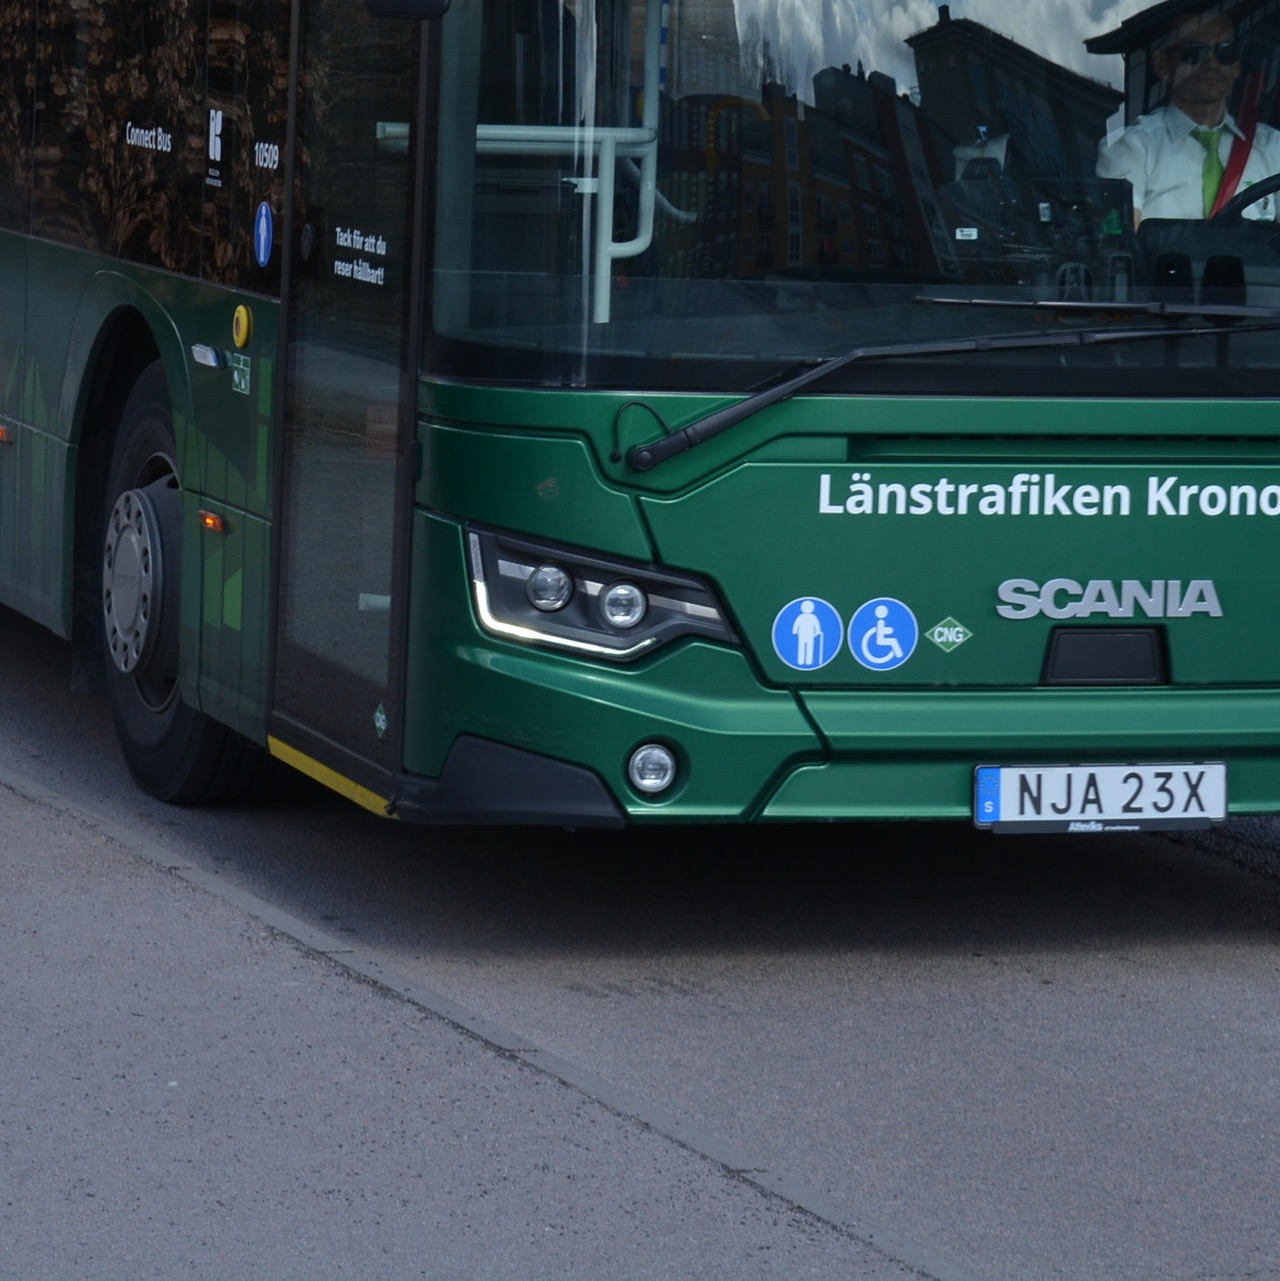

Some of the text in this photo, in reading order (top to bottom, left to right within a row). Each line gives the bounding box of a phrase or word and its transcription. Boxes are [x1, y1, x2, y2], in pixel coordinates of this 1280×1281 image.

[126, 121, 172, 153] Connect Bus
[254, 142, 280, 170] 10509
[335, 227, 387, 255] Tack för att du
[334, 259, 385, 285] reser hållbart!
[818, 473, 1132, 516] Länstrafiken
[995, 578, 1224, 620] SCANIA
[934, 627, 964, 642] CNG
[984, 801, 994, 813] S
[1018, 771, 1206, 816] NJA 23X
